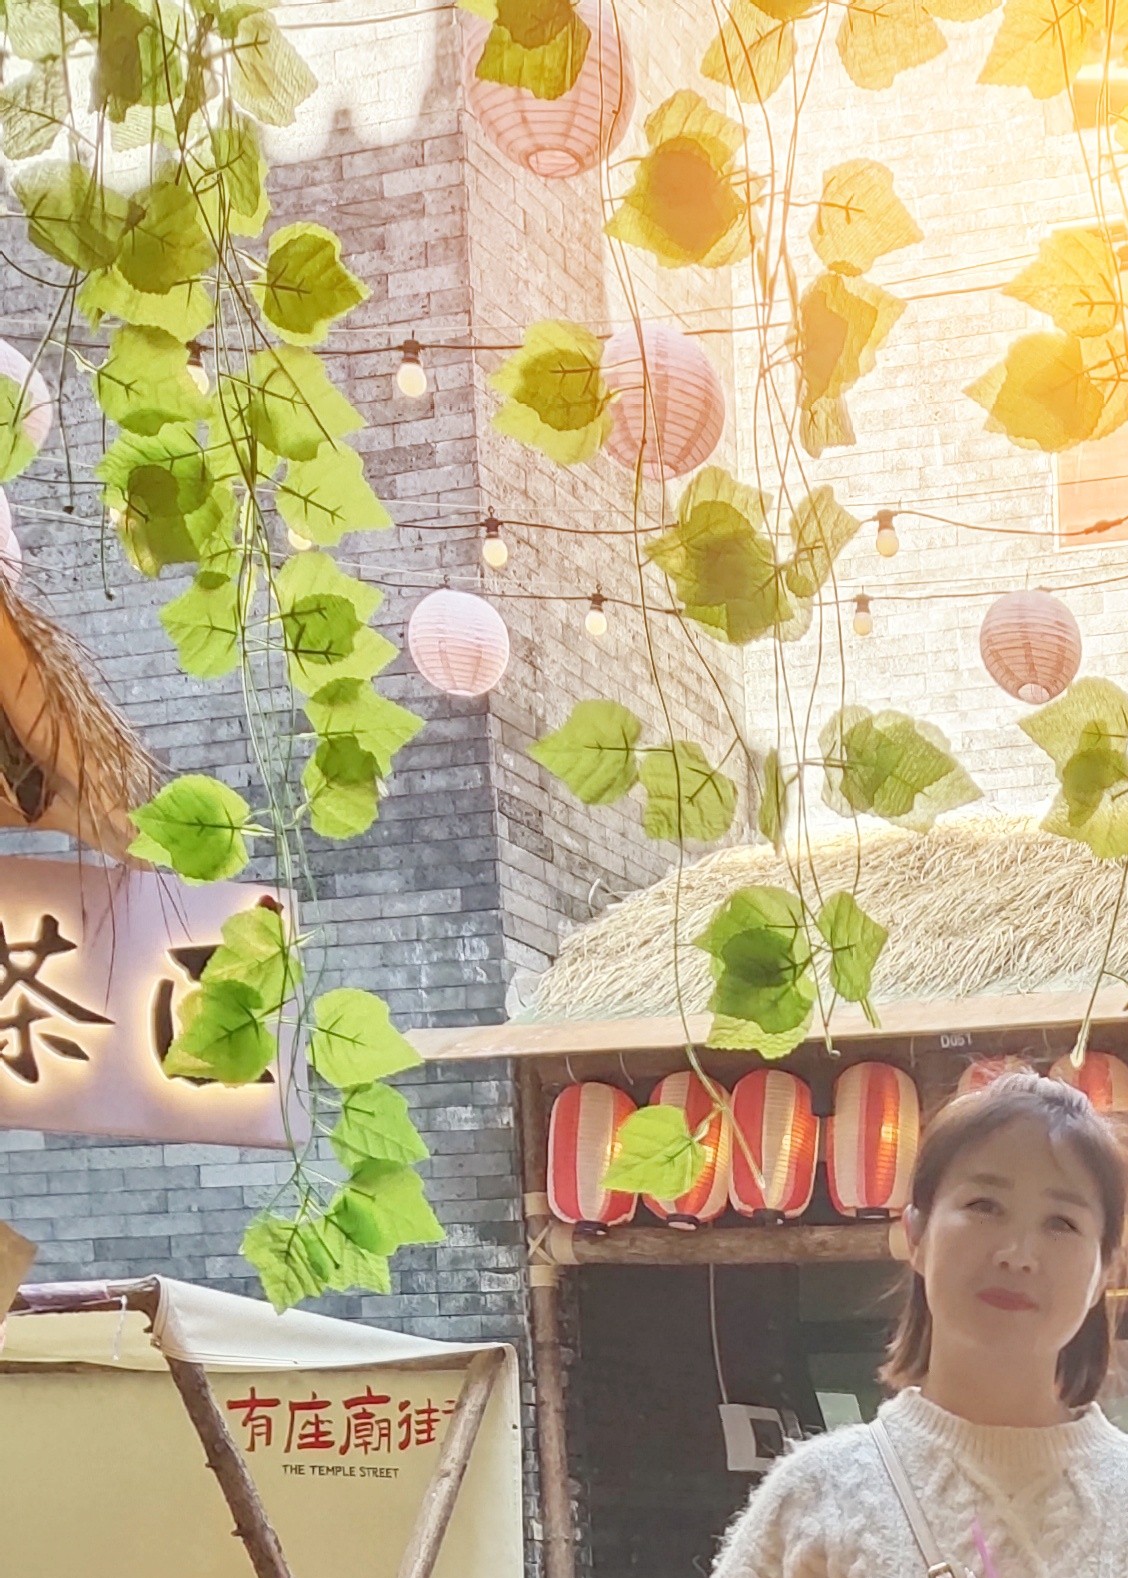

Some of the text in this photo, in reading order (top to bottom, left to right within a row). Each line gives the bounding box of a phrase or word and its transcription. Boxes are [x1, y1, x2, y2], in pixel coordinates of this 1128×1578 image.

[282, 1464, 399, 1479] THE TEMPLE STREET
